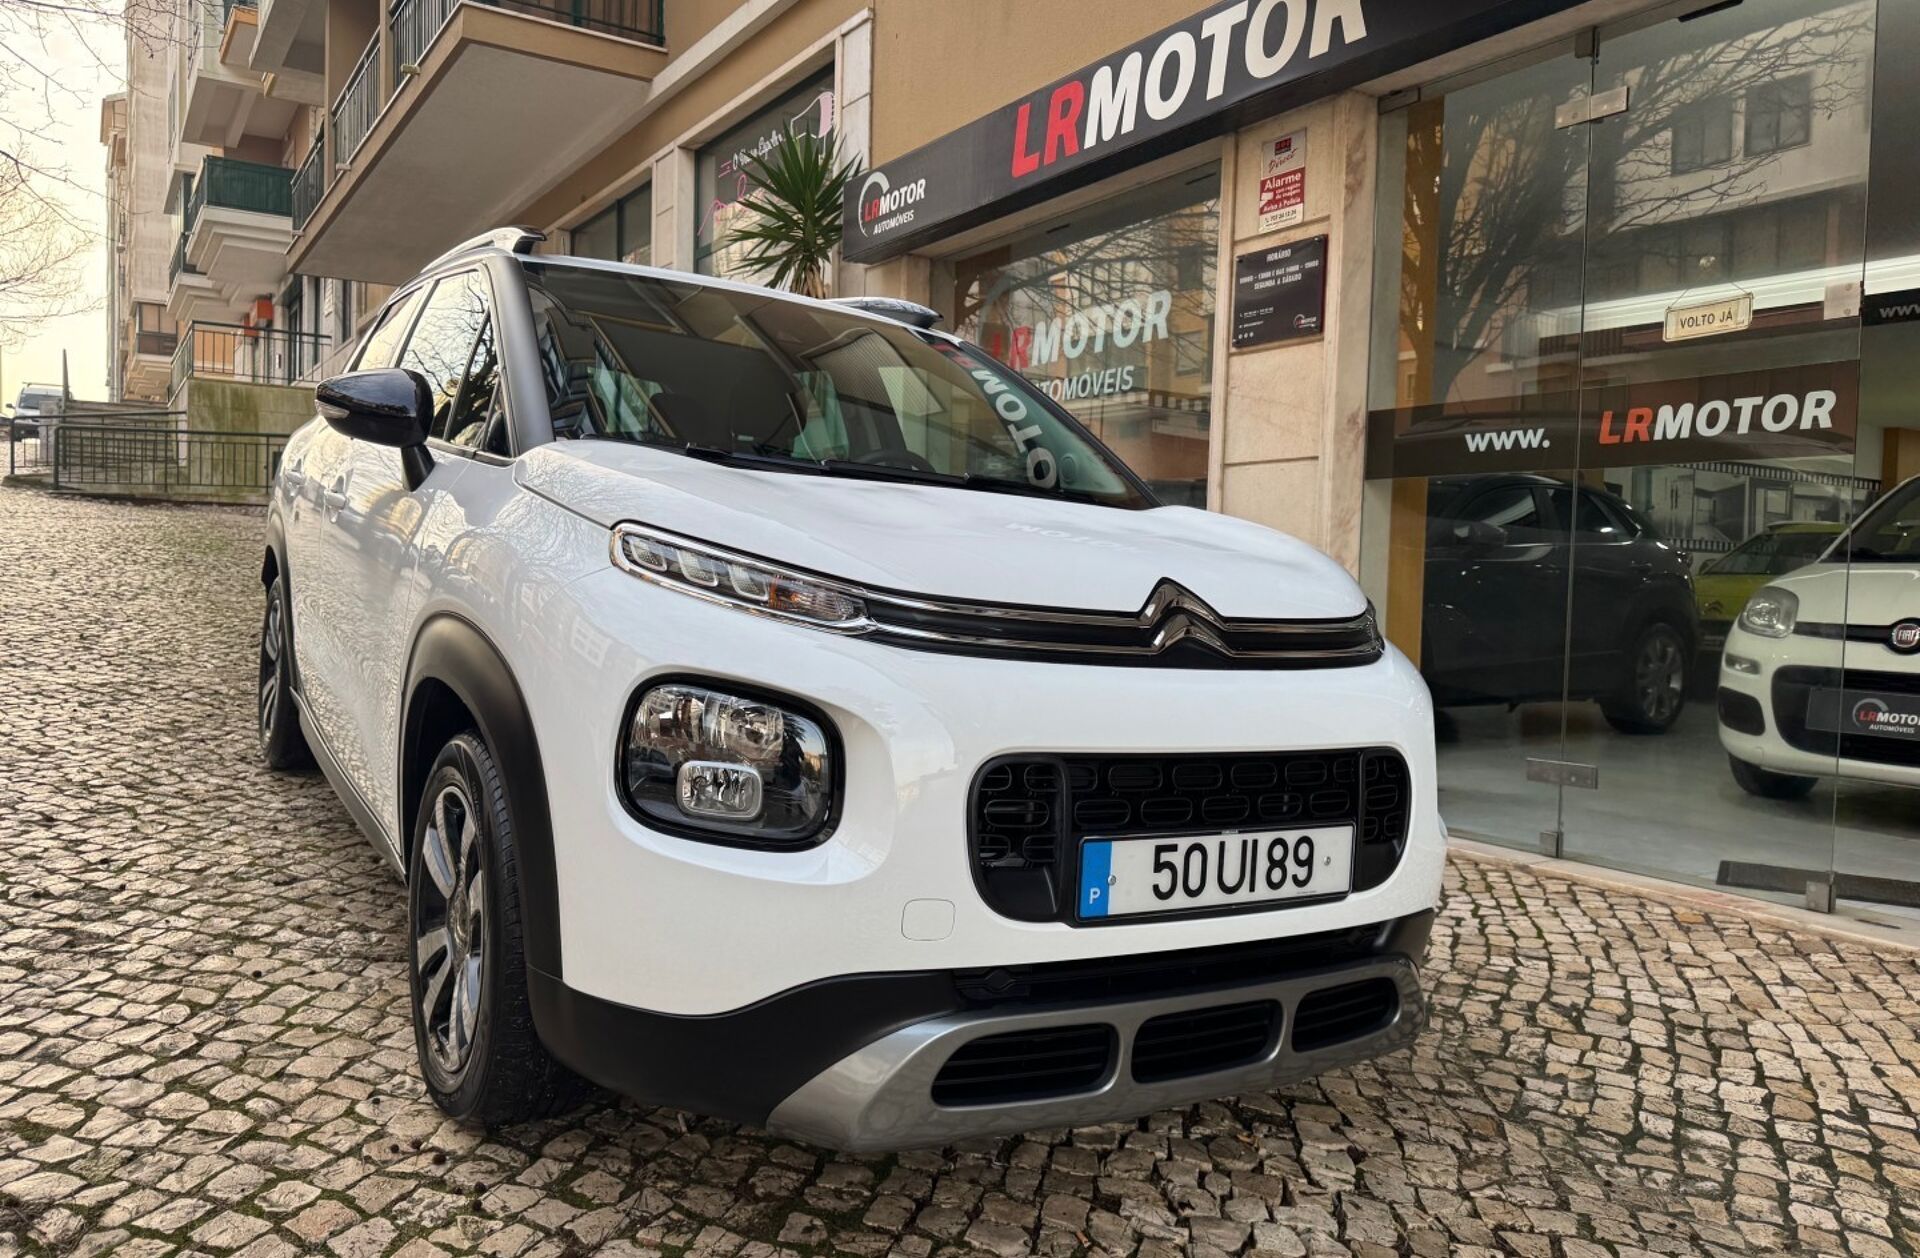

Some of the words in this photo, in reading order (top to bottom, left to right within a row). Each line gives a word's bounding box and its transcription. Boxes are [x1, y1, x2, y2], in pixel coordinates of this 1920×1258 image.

[1263, 171, 1302, 191] Alarme
[863, 178, 926, 223] LRMOTOR
[873, 209, 915, 236] AUTOMÓVEIS
[1680, 312, 1716, 330] VOLTO
[1719, 306, 1734, 323] JÁ
[1465, 427, 1551, 453] www.
[1598, 389, 1838, 445] LRMOTOR
[1897, 629, 1918, 642] FIAT
[1860, 710, 1920, 726] LRMOTO
[1089, 886, 1101, 905] P
